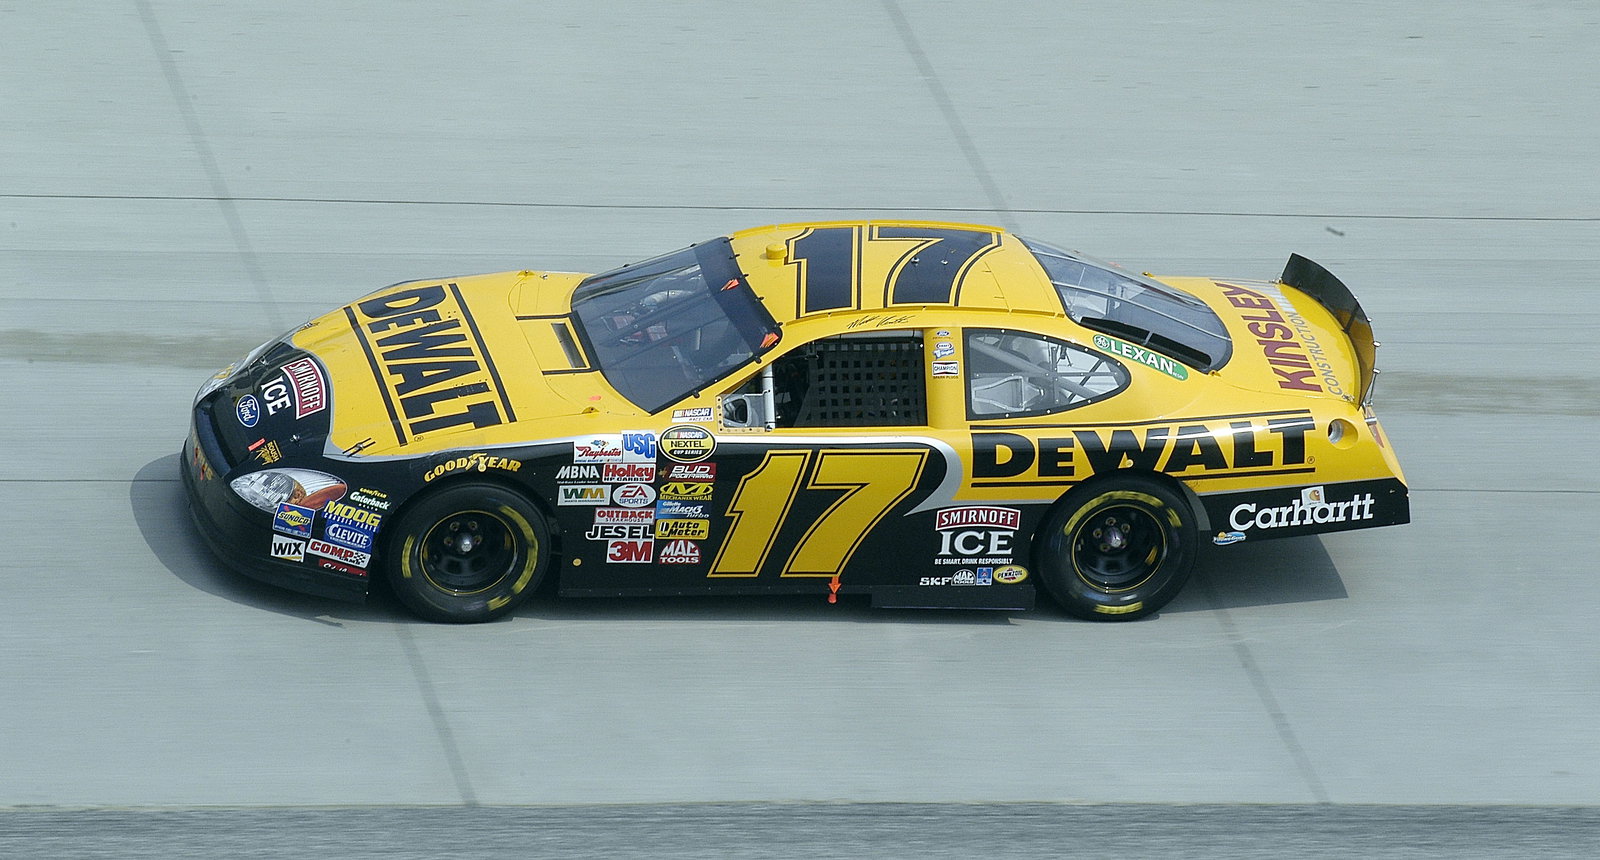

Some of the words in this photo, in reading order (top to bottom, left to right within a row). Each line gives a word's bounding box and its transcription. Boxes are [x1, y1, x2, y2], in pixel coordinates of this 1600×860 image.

[784, 225, 1003, 319] 17
[1214, 282, 1324, 393] KINSLEY
[1110, 340, 1174, 376] LEXAN
[1289, 310, 1343, 396] CONSTRUCTION
[934, 364, 957, 372] CHAMPION
[288, 361, 321, 410] SMIRNOFF
[260, 376, 292, 417] ICE
[239, 398, 256, 422] Ford
[684, 407, 710, 418] NASCAR
[679, 431, 705, 439] NASCAR
[576, 446, 622, 459] Raybestos
[622, 433, 656, 459] USG
[670, 440, 704, 448] NEXTEL
[424, 453, 522, 482] GOODYEAR
[555, 465, 601, 480] MBNA
[603, 464, 655, 483] Holley
[671, 465, 711, 474] BUD
[350, 491, 389, 510] Gatorback
[563, 488, 605, 500] WM
[620, 485, 648, 499] EA
[279, 512, 310, 525] SUNOCO
[323, 501, 382, 527] MOOG
[597, 510, 653, 519] OUTBACK
[706, 449, 930, 578] 17
[940, 509, 1016, 527] SMIRNOFF
[1229, 492, 1375, 532] Carhartt
[587, 526, 654, 540] JESEL
[668, 528, 705, 537] Meter
[671, 521, 700, 530] Auto
[328, 523, 369, 546] CLEVITE
[937, 530, 1014, 556] ICE
[273, 542, 303, 556] WIX
[311, 541, 354, 558] COMP
[609, 541, 653, 562] 3M
[660, 540, 700, 557] MAC
[660, 556, 699, 564] TOOLS
[978, 558, 1014, 566] RESPONSIBLY
[919, 577, 952, 587] SKF
[952, 570, 975, 581] MAC
